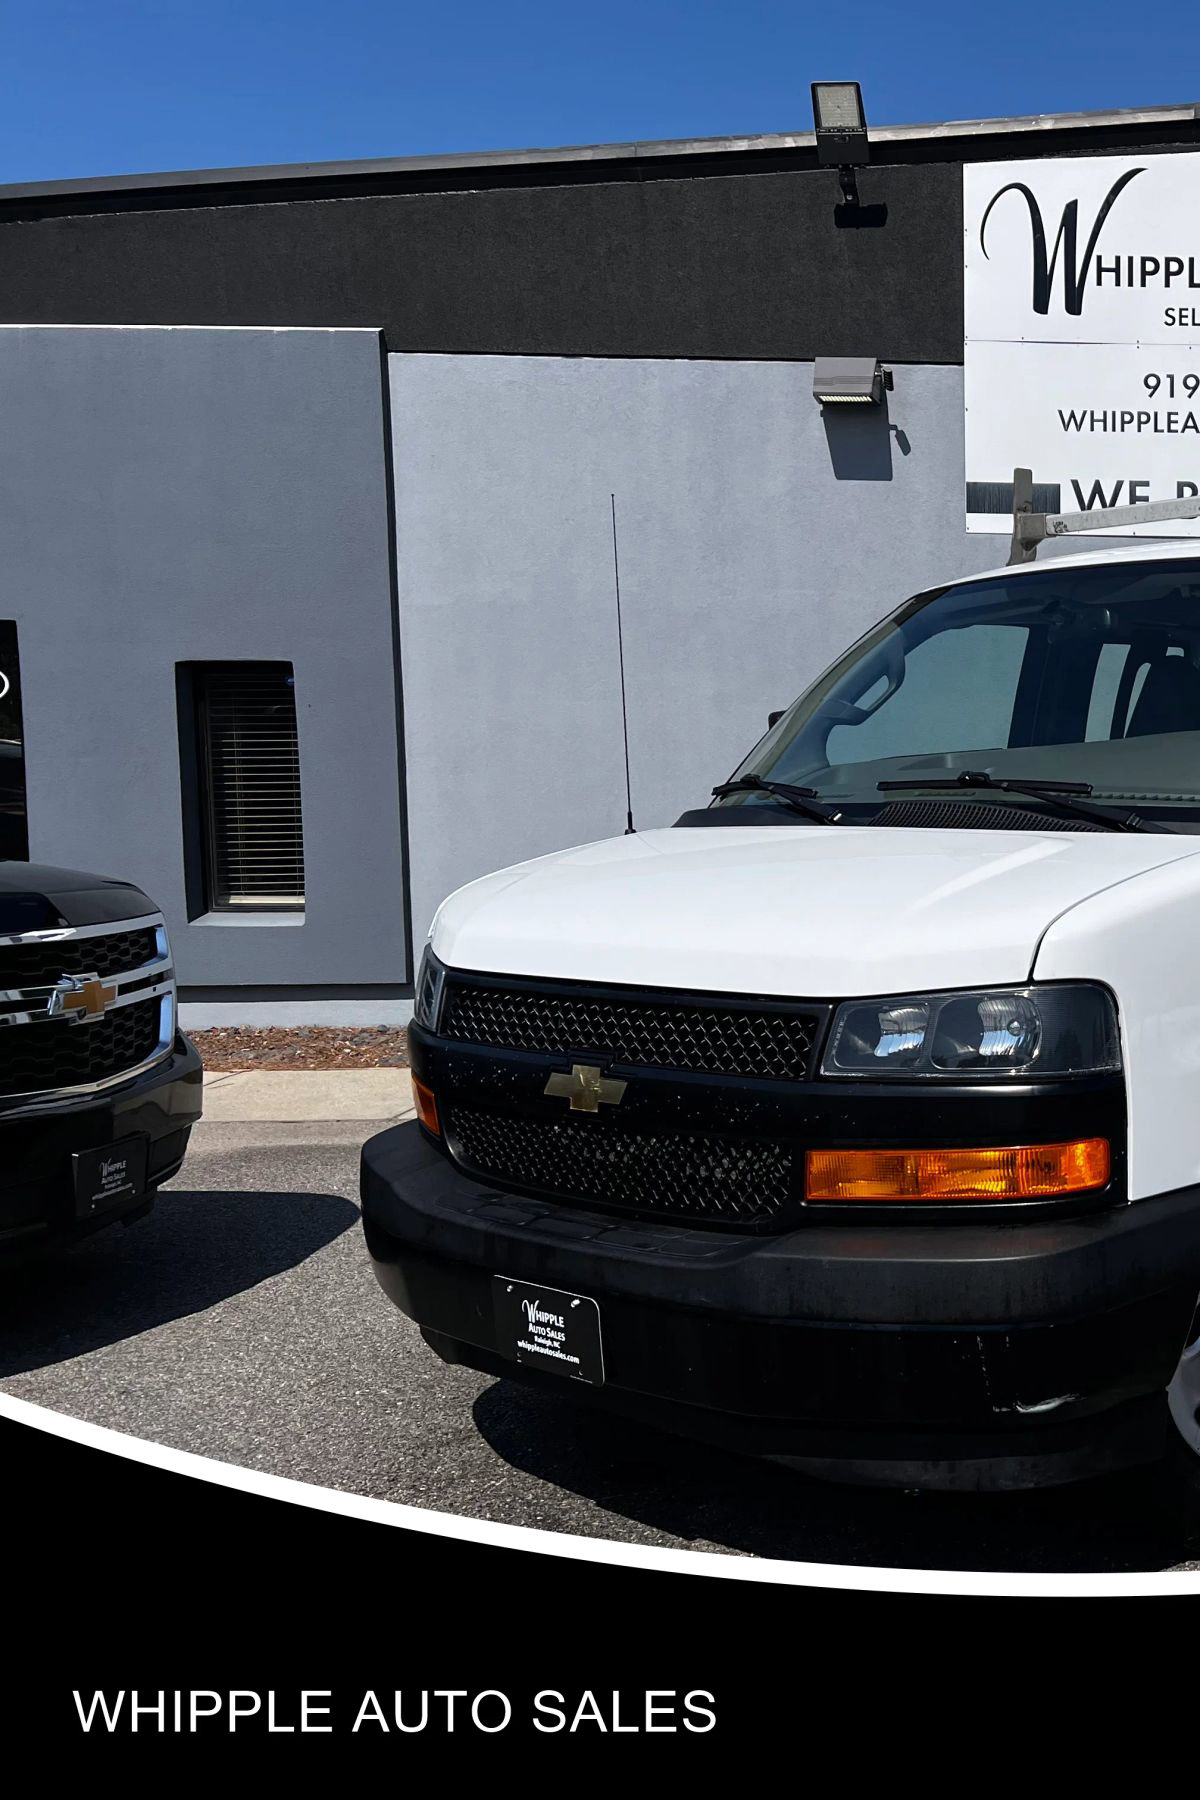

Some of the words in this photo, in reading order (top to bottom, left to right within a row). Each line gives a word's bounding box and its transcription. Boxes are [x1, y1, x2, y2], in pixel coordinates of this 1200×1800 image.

[1070, 479, 1150, 512] WE
[521, 1299, 565, 1328] WHIPPLE
[528, 1322, 547, 1336] AUTO
[545, 1327, 566, 1342] SALES
